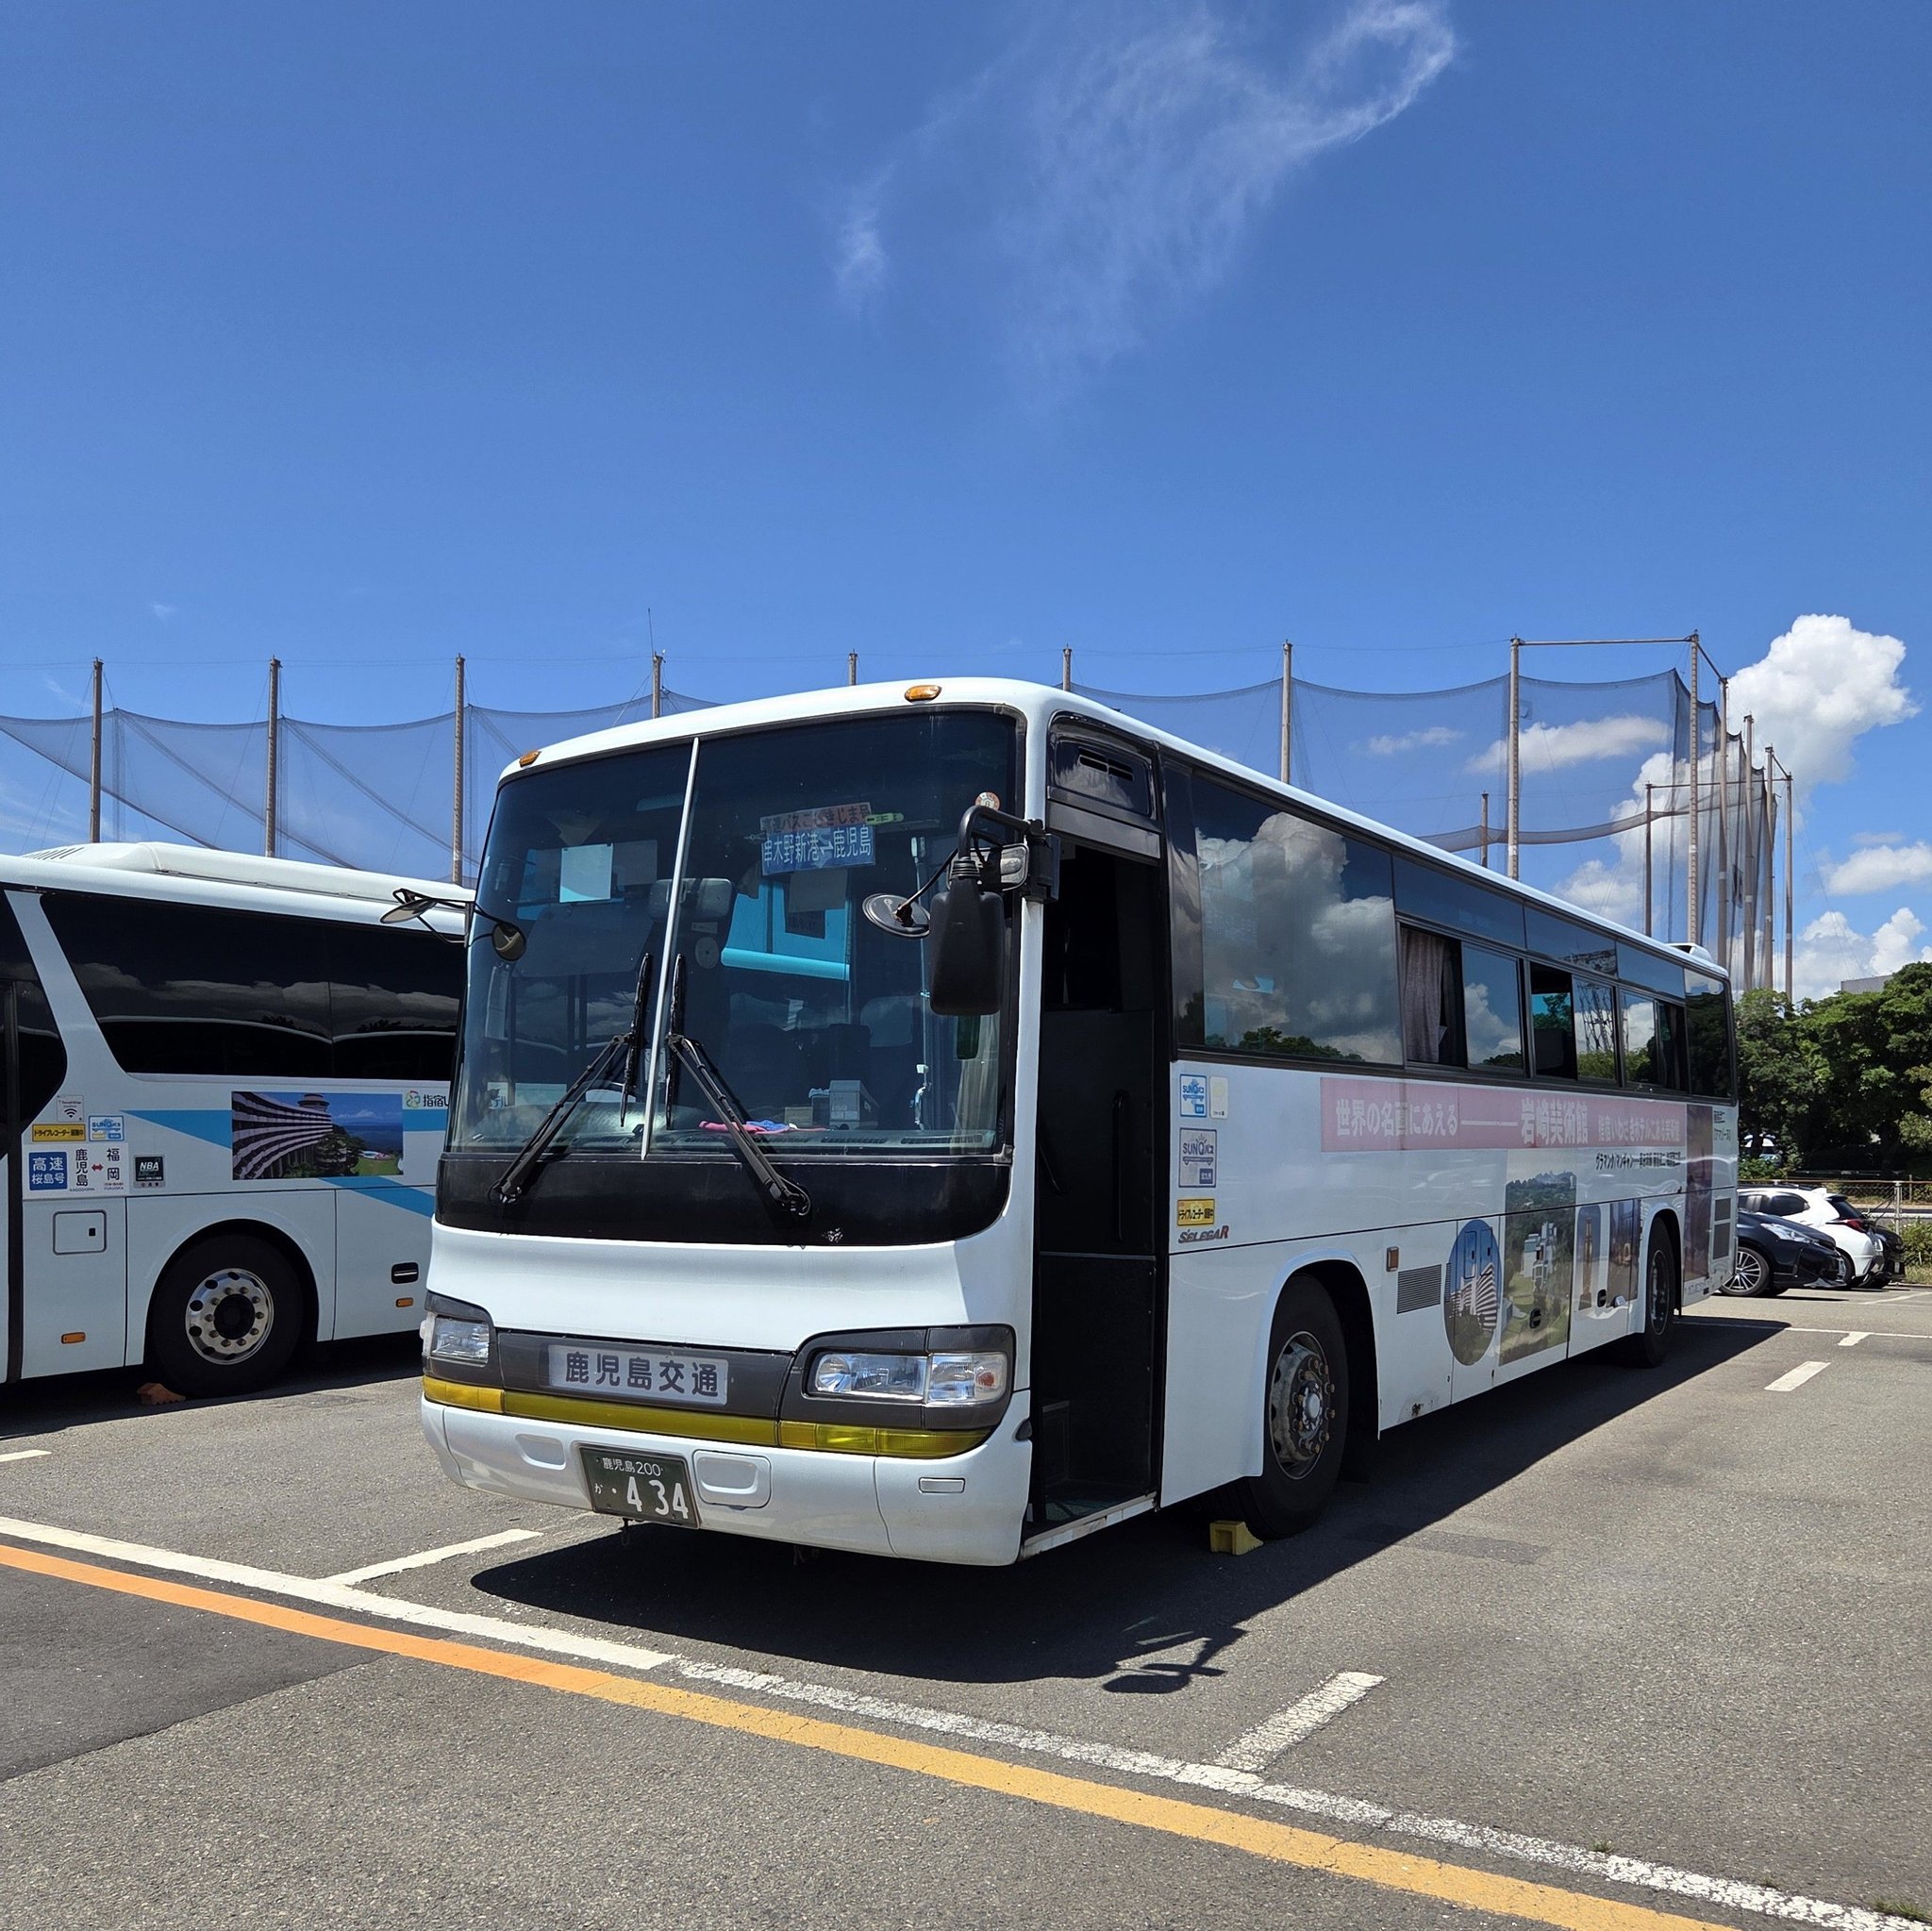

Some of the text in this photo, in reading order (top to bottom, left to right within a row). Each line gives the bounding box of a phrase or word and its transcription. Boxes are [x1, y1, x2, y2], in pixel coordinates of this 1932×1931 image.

[763, 824, 872, 867] 串木野新港 鹿児島
[1336, 1098, 1458, 1137] 世界の名画にあえる
[1521, 1097, 1589, 1145] 岩崎美術館
[31, 1173, 65, 1185] 桜島号
[32, 1157, 64, 1172] 高速
[75, 1148, 89, 1187] 鹿児島
[107, 1147, 120, 1180] 福岡
[140, 1161, 159, 1171] NBA
[566, 1352, 718, 1397] 鹿児島交通
[594, 1482, 604, 1494] か
